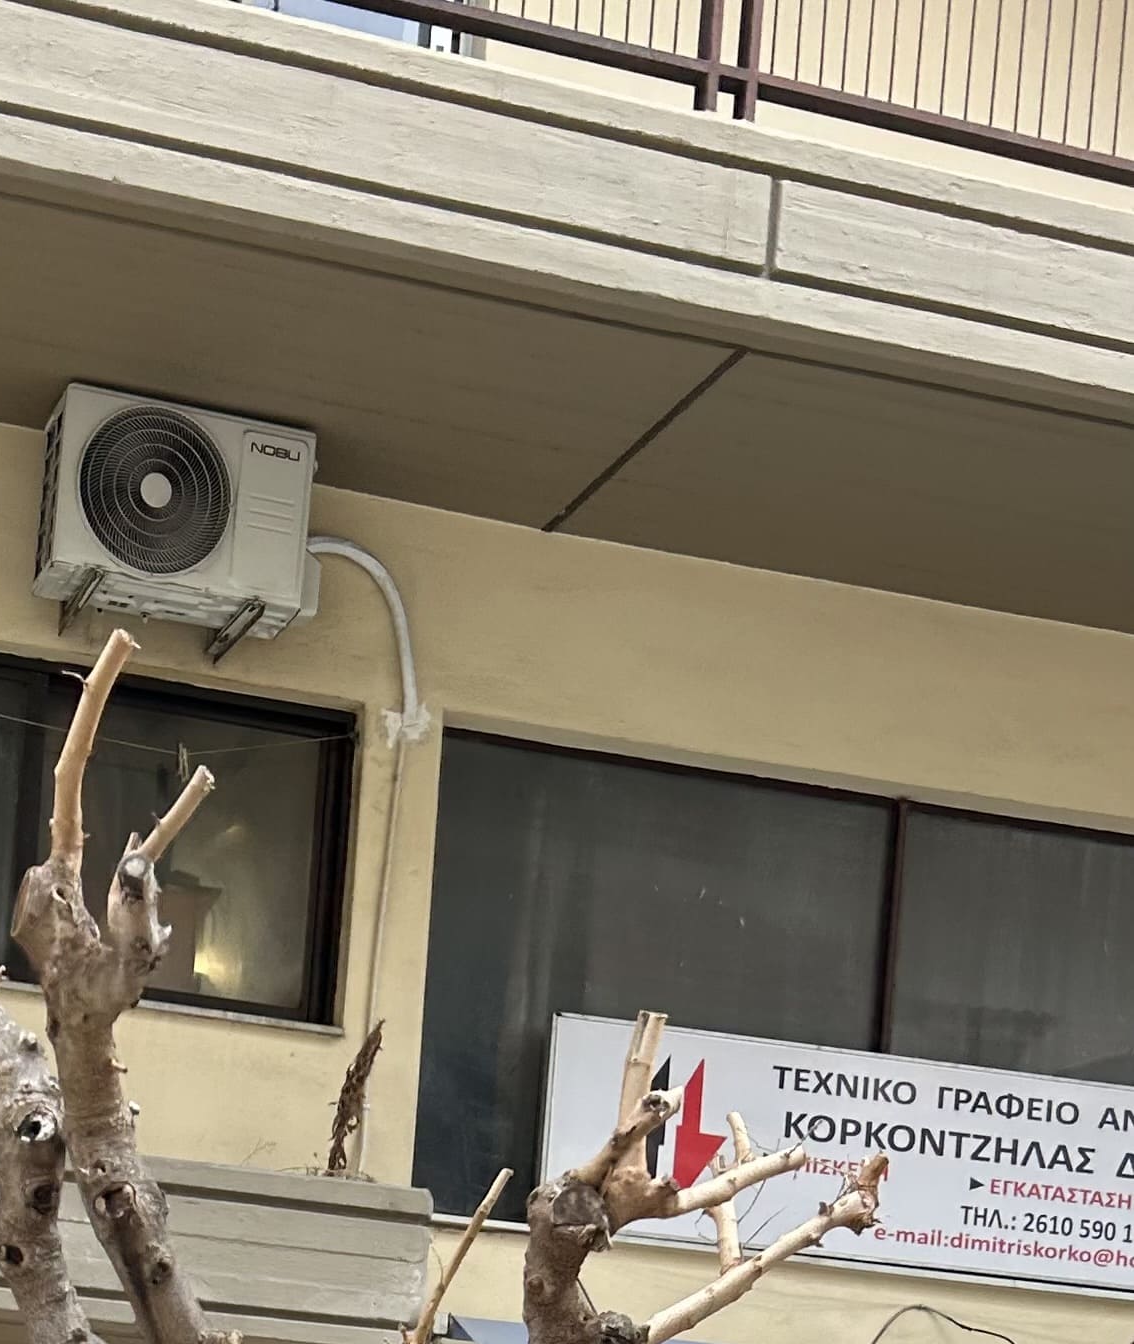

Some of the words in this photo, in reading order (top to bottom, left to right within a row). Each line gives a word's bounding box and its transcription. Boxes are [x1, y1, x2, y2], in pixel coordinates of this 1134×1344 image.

[250, 441, 301, 462] NOBU
[772, 1064, 918, 1105] ΤΕΧΝΙΚΟ
[937, 1085, 1080, 1126] ΓΡΑΦΕΙΟ
[783, 1110, 1097, 1174] ΚΟΡΚΟΝΤΖΗΛΑΣ
[989, 1178, 1133, 1210] ΕΓΚΑΤΑΣΤΑΣΗ
[960, 1205, 1017, 1230] ΤΗΛ.:
[1022, 1212, 1073, 1237] 2610
[1078, 1219, 1117, 1242] 590
